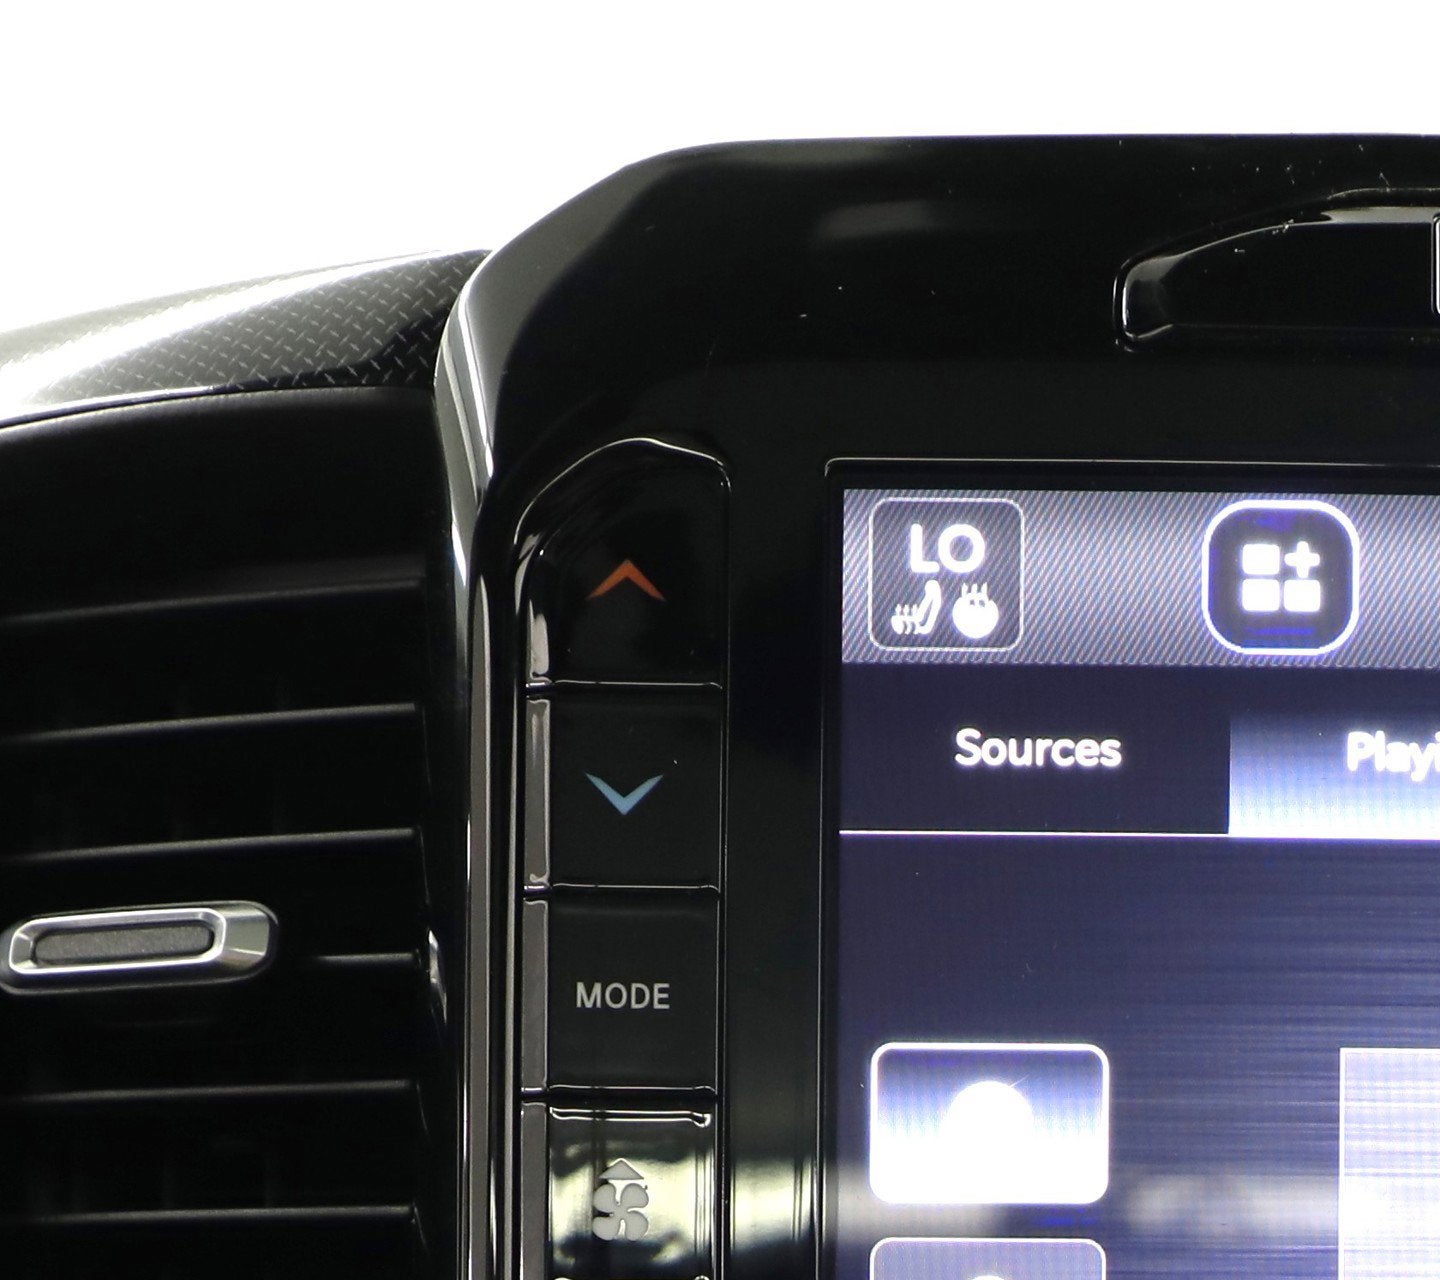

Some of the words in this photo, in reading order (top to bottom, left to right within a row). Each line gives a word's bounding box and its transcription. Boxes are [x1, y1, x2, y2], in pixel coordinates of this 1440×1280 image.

[909, 523, 986, 574] LO
[955, 728, 1121, 768] Sources
[576, 983, 670, 1010] MODE
